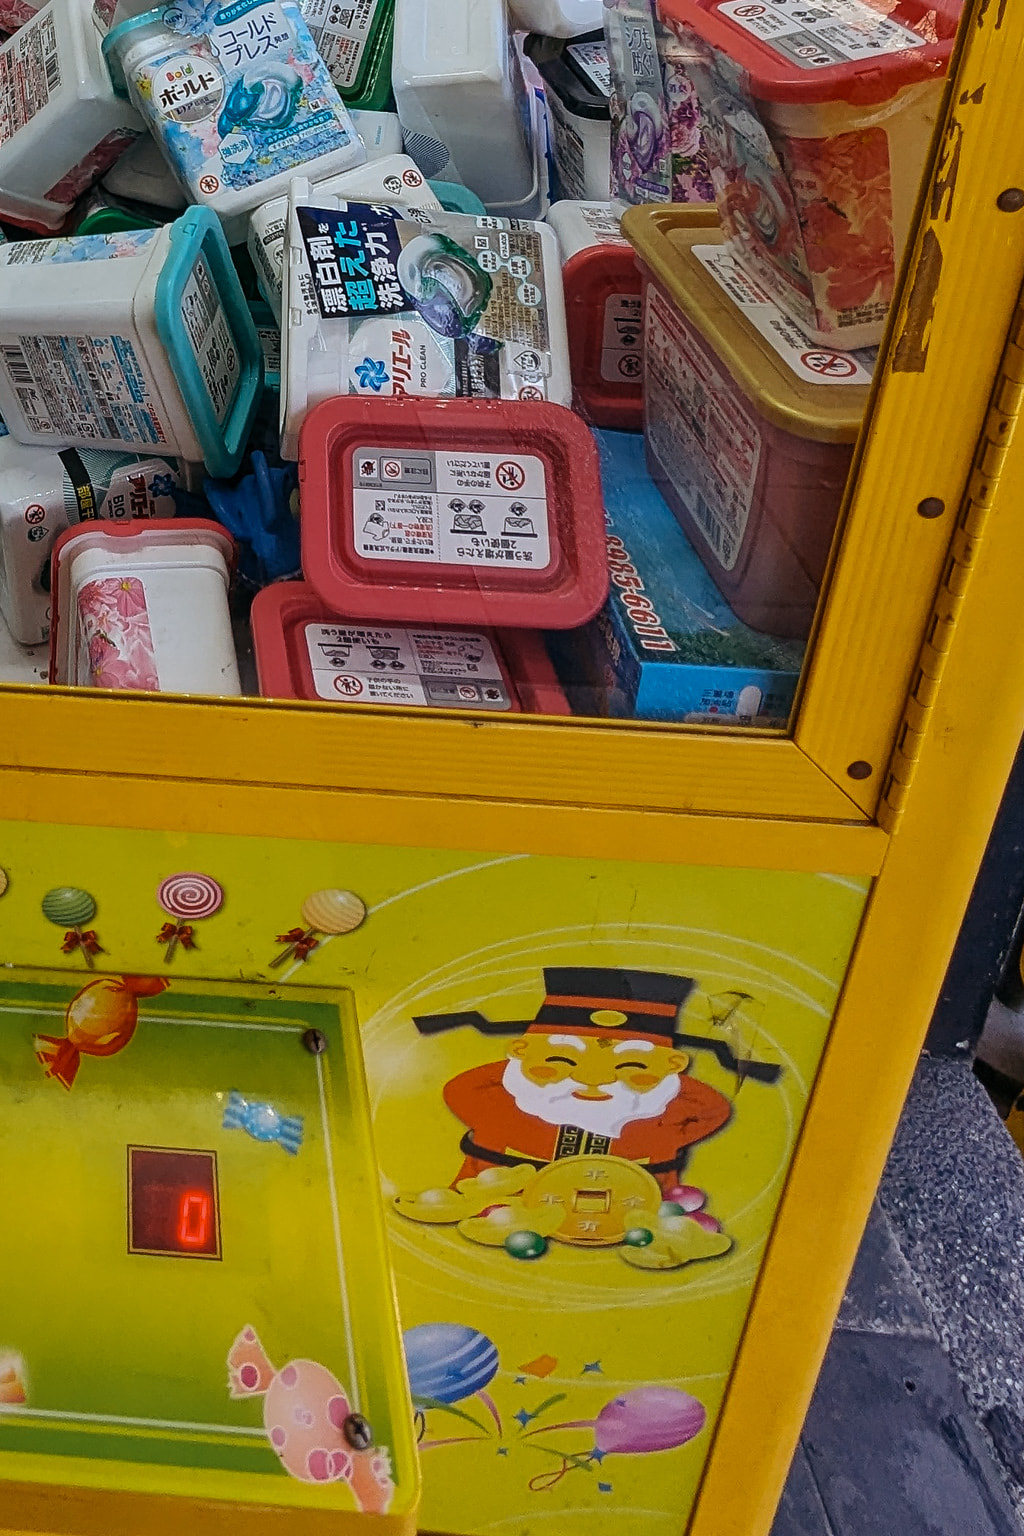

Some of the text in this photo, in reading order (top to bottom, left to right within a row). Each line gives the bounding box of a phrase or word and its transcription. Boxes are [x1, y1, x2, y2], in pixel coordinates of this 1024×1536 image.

[218, 12, 277, 49] コールド
[224, 35, 279, 66] プレス
[158, 70, 216, 110] ボールド
[165, 62, 195, 83] Bold
[306, 221, 350, 313] 漂白剤を
[333, 219, 380, 312] 超えた
[419, 344, 427, 388] PRO CLEAN
[113, 494, 125, 518] BIO
[456, 547, 533, 562] 洗う量が増えたら
[471, 537, 517, 549] 2個使いも
[180, 1192, 208, 1243] 0
